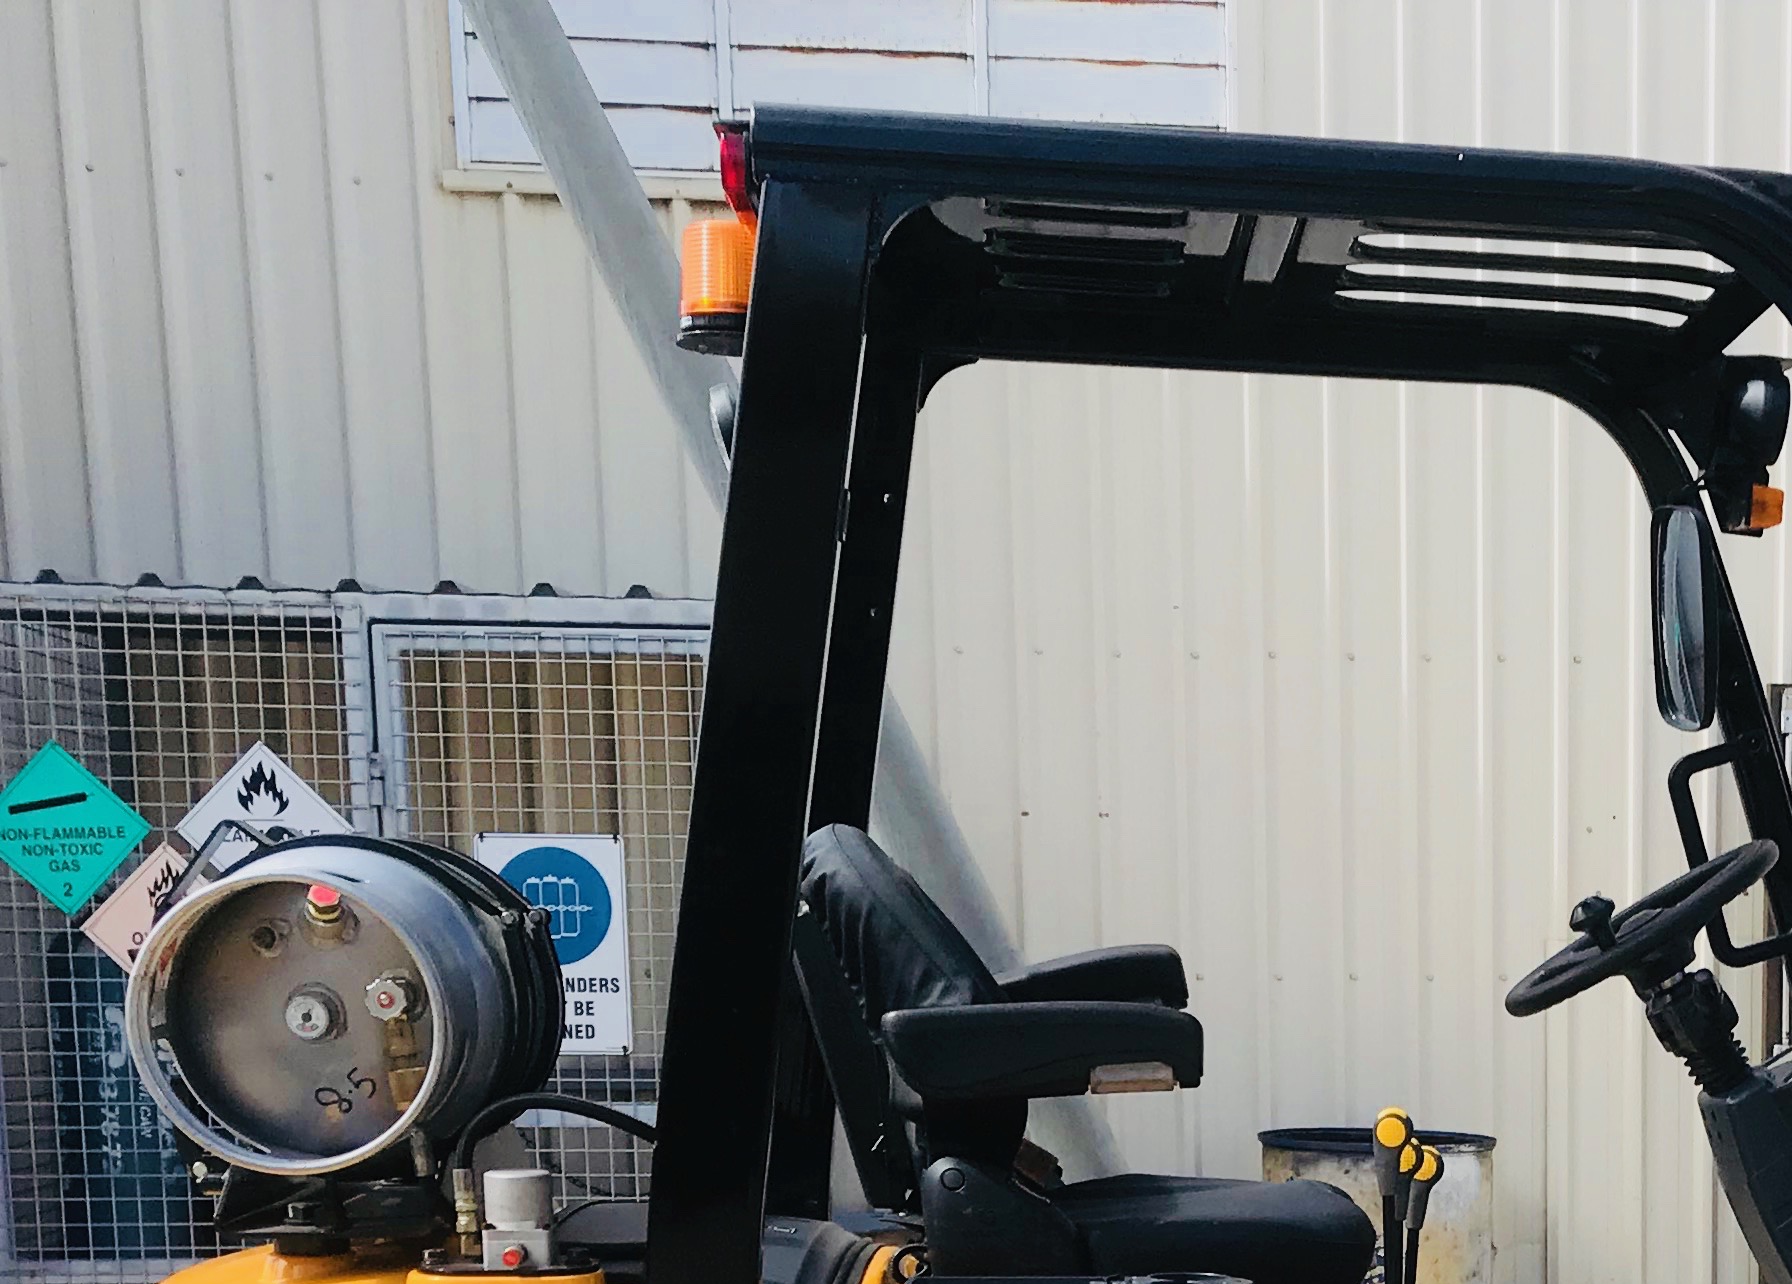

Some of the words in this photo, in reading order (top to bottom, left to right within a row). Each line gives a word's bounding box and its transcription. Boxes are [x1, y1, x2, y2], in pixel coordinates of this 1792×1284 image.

[21, 843, 104, 856] NON-TOXIC
[49, 860, 81, 872] GAS
[63, 882, 73, 897] 2
[565, 977, 620, 993] NDERS
[574, 1001, 595, 1016] BE
